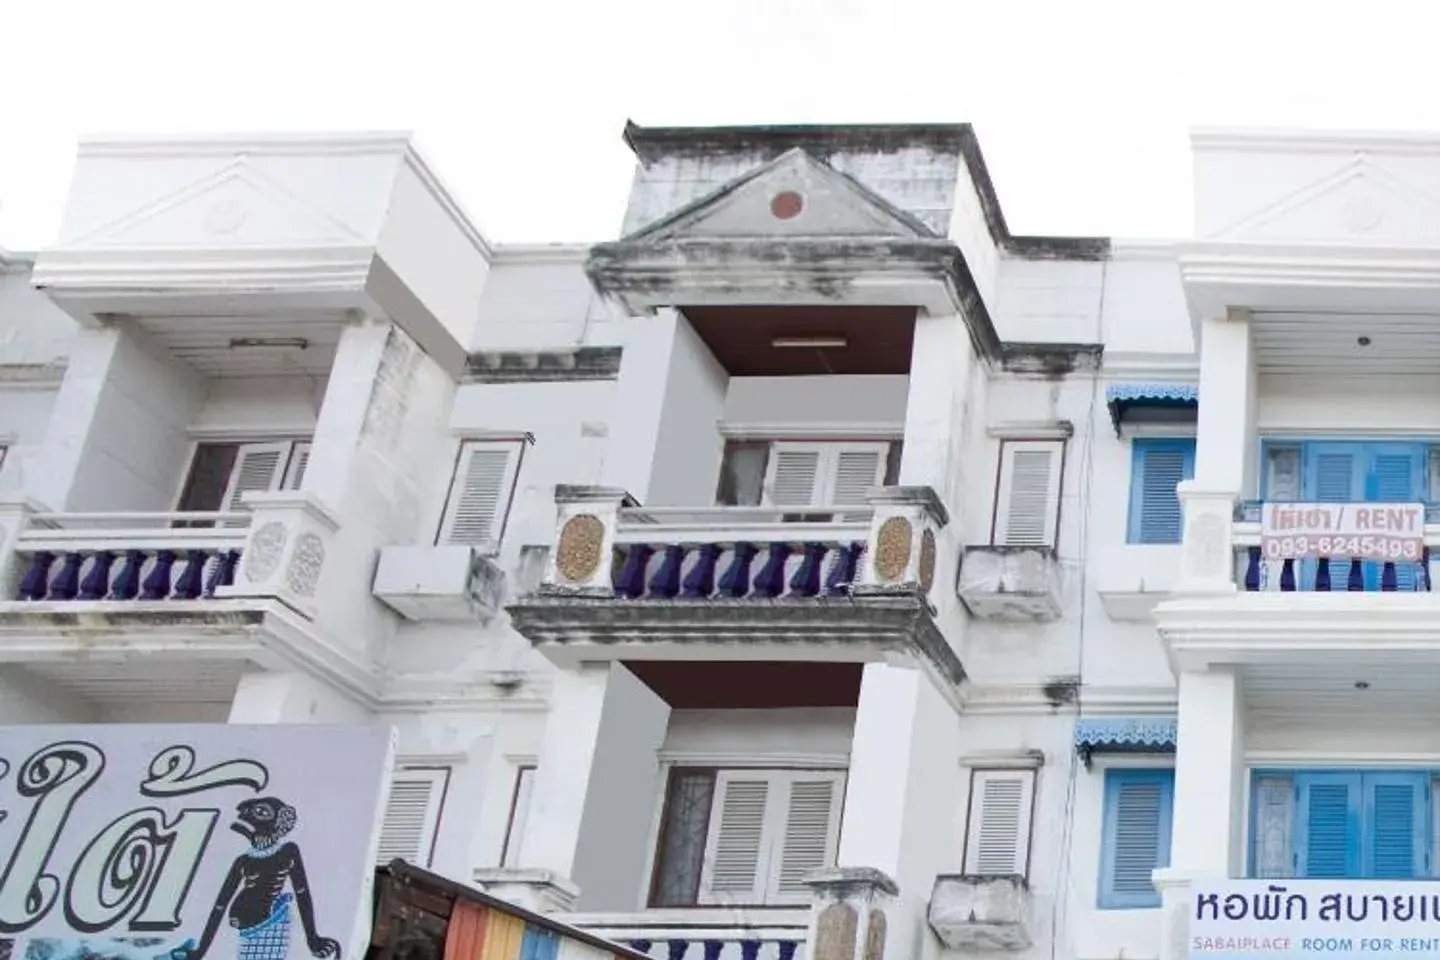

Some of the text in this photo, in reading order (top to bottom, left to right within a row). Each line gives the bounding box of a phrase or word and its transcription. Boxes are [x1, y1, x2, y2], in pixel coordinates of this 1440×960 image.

[1356, 507, 1419, 531] RENT
[1266, 535, 1417, 559] 093-6245493
[1196, 885, 1308, 921] หอพัก
[1193, 937, 1440, 952] SABAIPLACE ROOM FOR RENT
